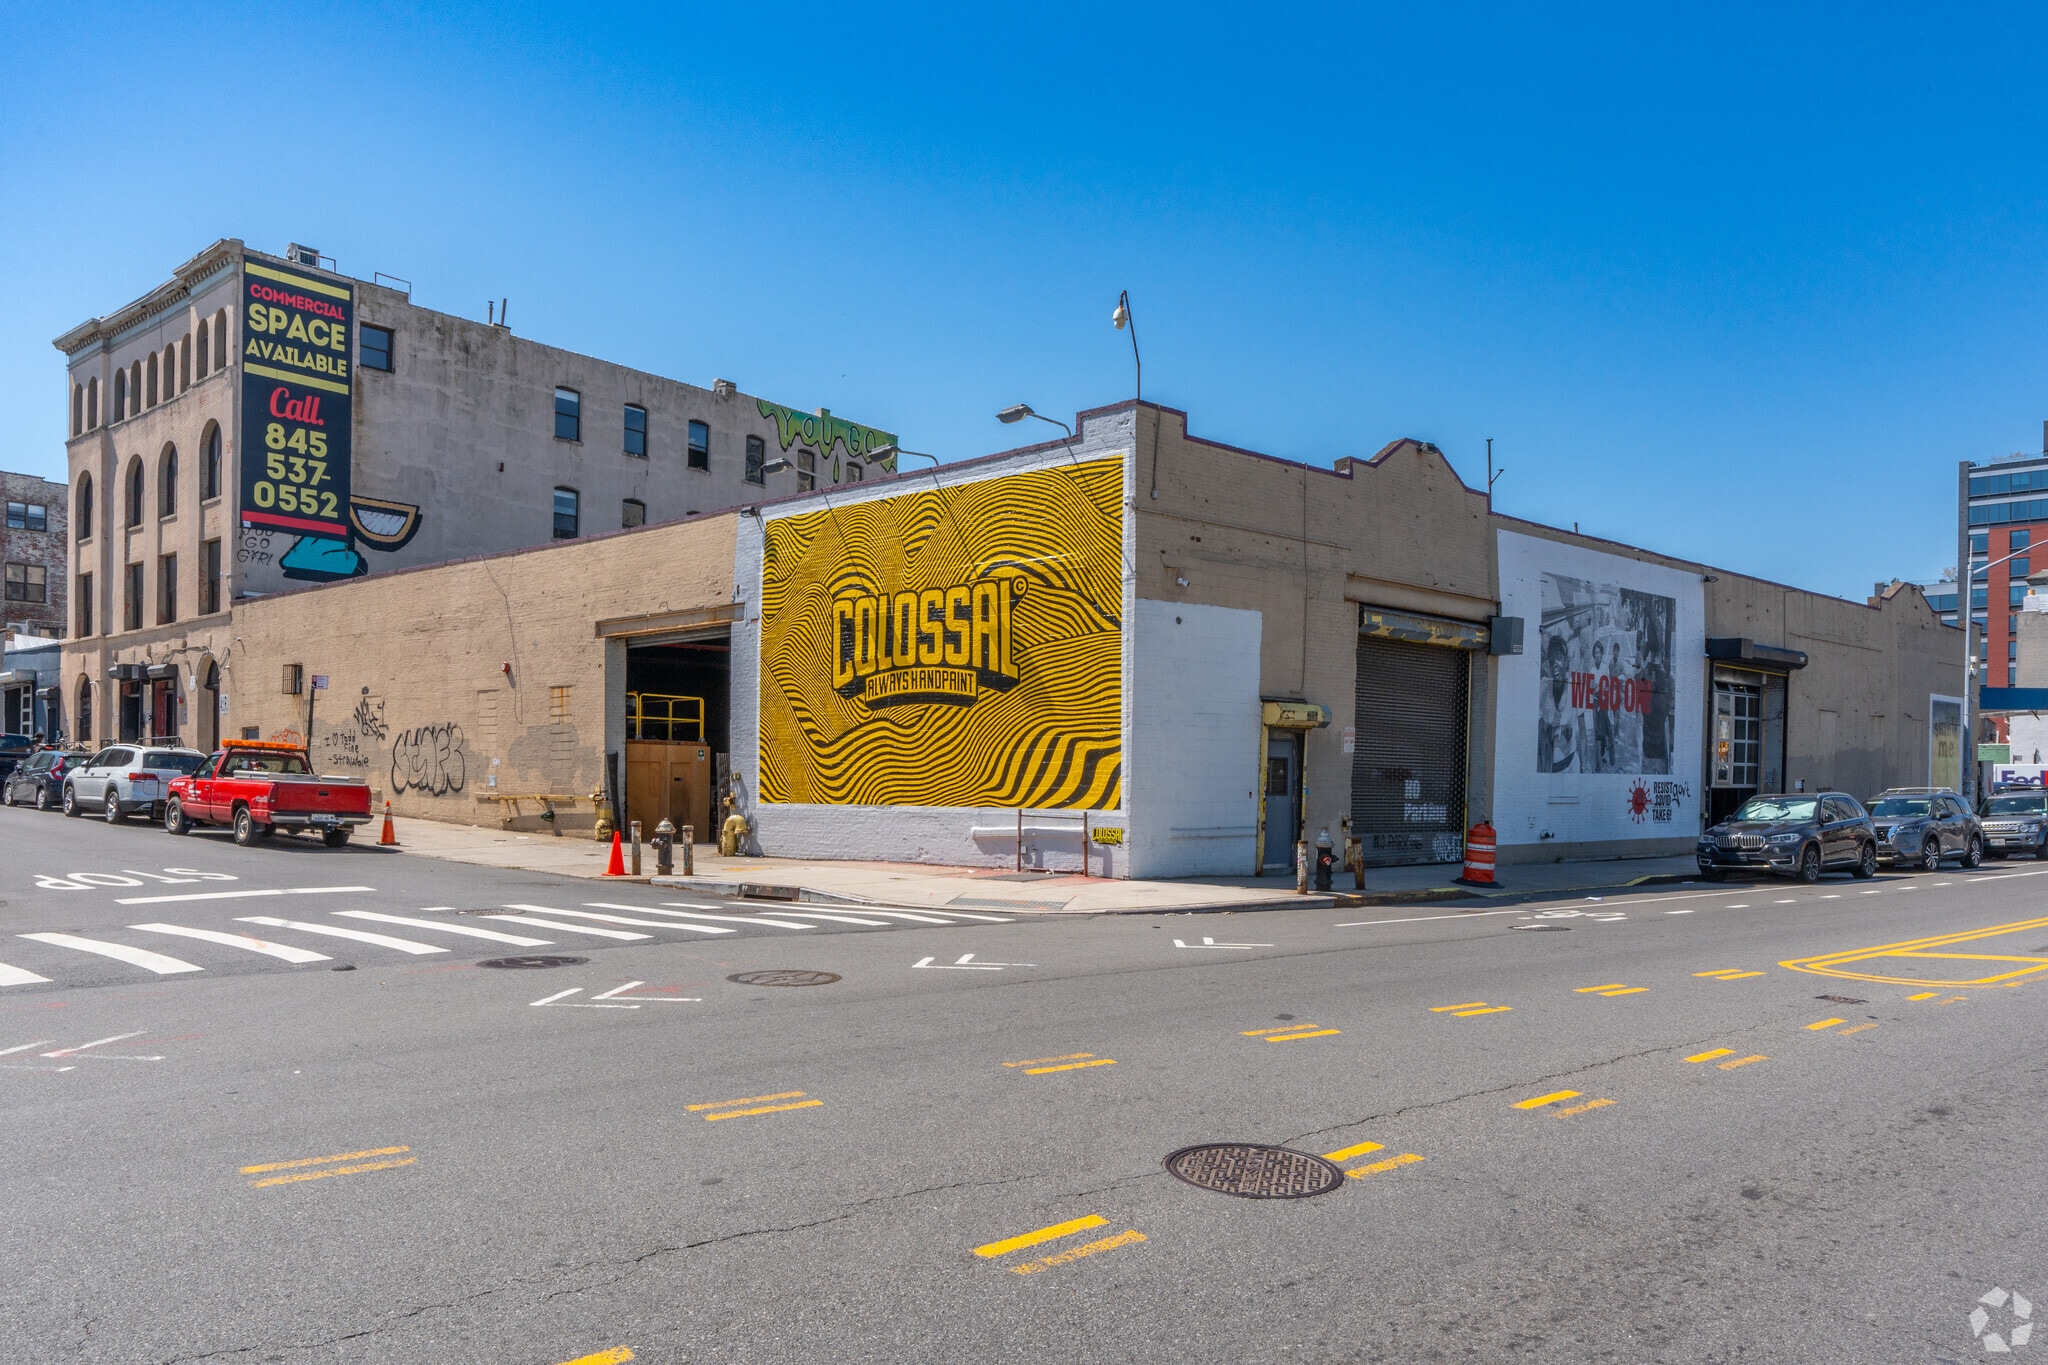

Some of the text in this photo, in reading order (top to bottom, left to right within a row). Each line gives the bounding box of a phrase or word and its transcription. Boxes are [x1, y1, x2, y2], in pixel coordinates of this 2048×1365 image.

[250, 283, 346, 321] COMMERCIAL
[248, 302, 346, 352] SPACE
[245, 337, 347, 378] AVAILABLE
[265, 422, 328, 458] 845
[780, 407, 876, 454] YOU GO
[266, 452, 331, 486] 537-
[253, 480, 339, 518] 0552
[245, 537, 270, 549] GO
[832, 577, 1020, 690] COLOSSAL
[867, 669, 974, 699] ALWAYS HANDPAINT
[1571, 671, 1595, 710] WE
[1598, 675, 1621, 712] GO
[340, 729, 356, 745] Todd
[1653, 781, 1673, 793] RESIST
[1652, 809, 1666, 821] TAKE
[32, 867, 240, 890] STOP
